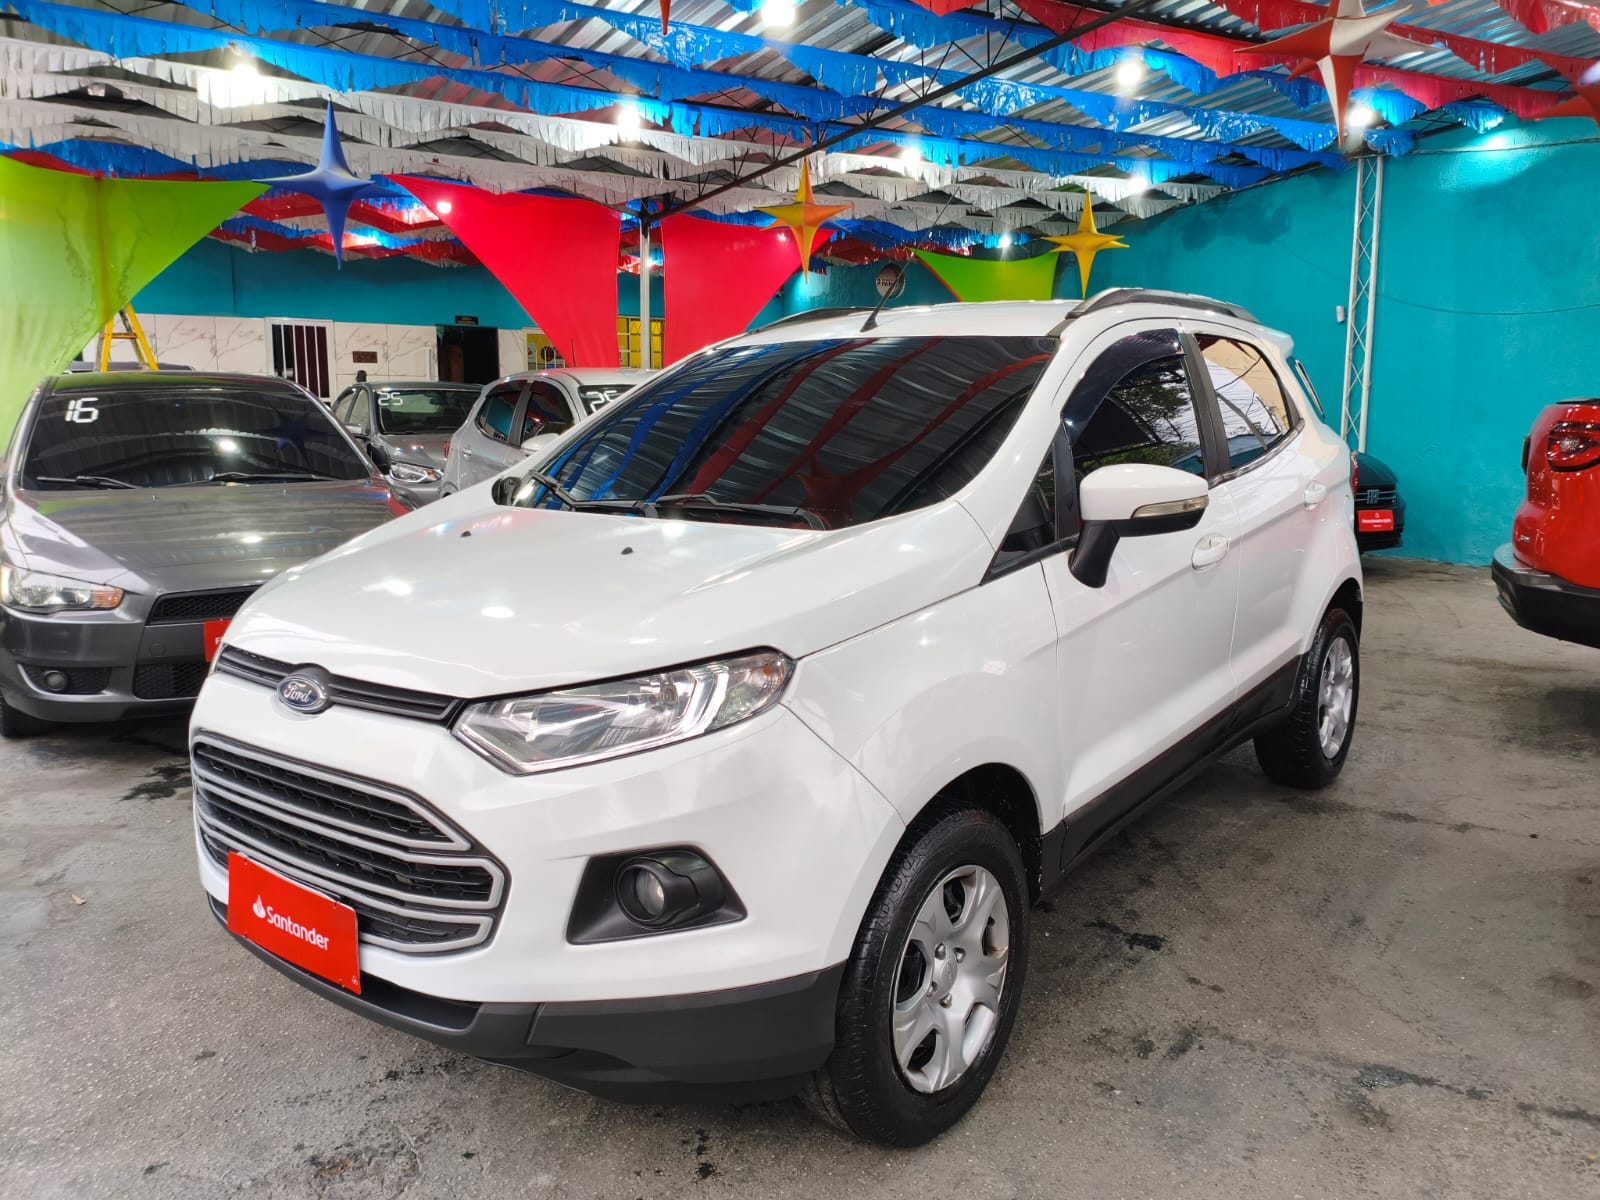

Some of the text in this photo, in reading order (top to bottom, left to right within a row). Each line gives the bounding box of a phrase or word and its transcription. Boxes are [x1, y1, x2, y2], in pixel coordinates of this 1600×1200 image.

[65, 397, 99, 423] 16
[377, 391, 404, 406] 25
[283, 681, 313, 703] Ford
[266, 905, 330, 951] Santander
